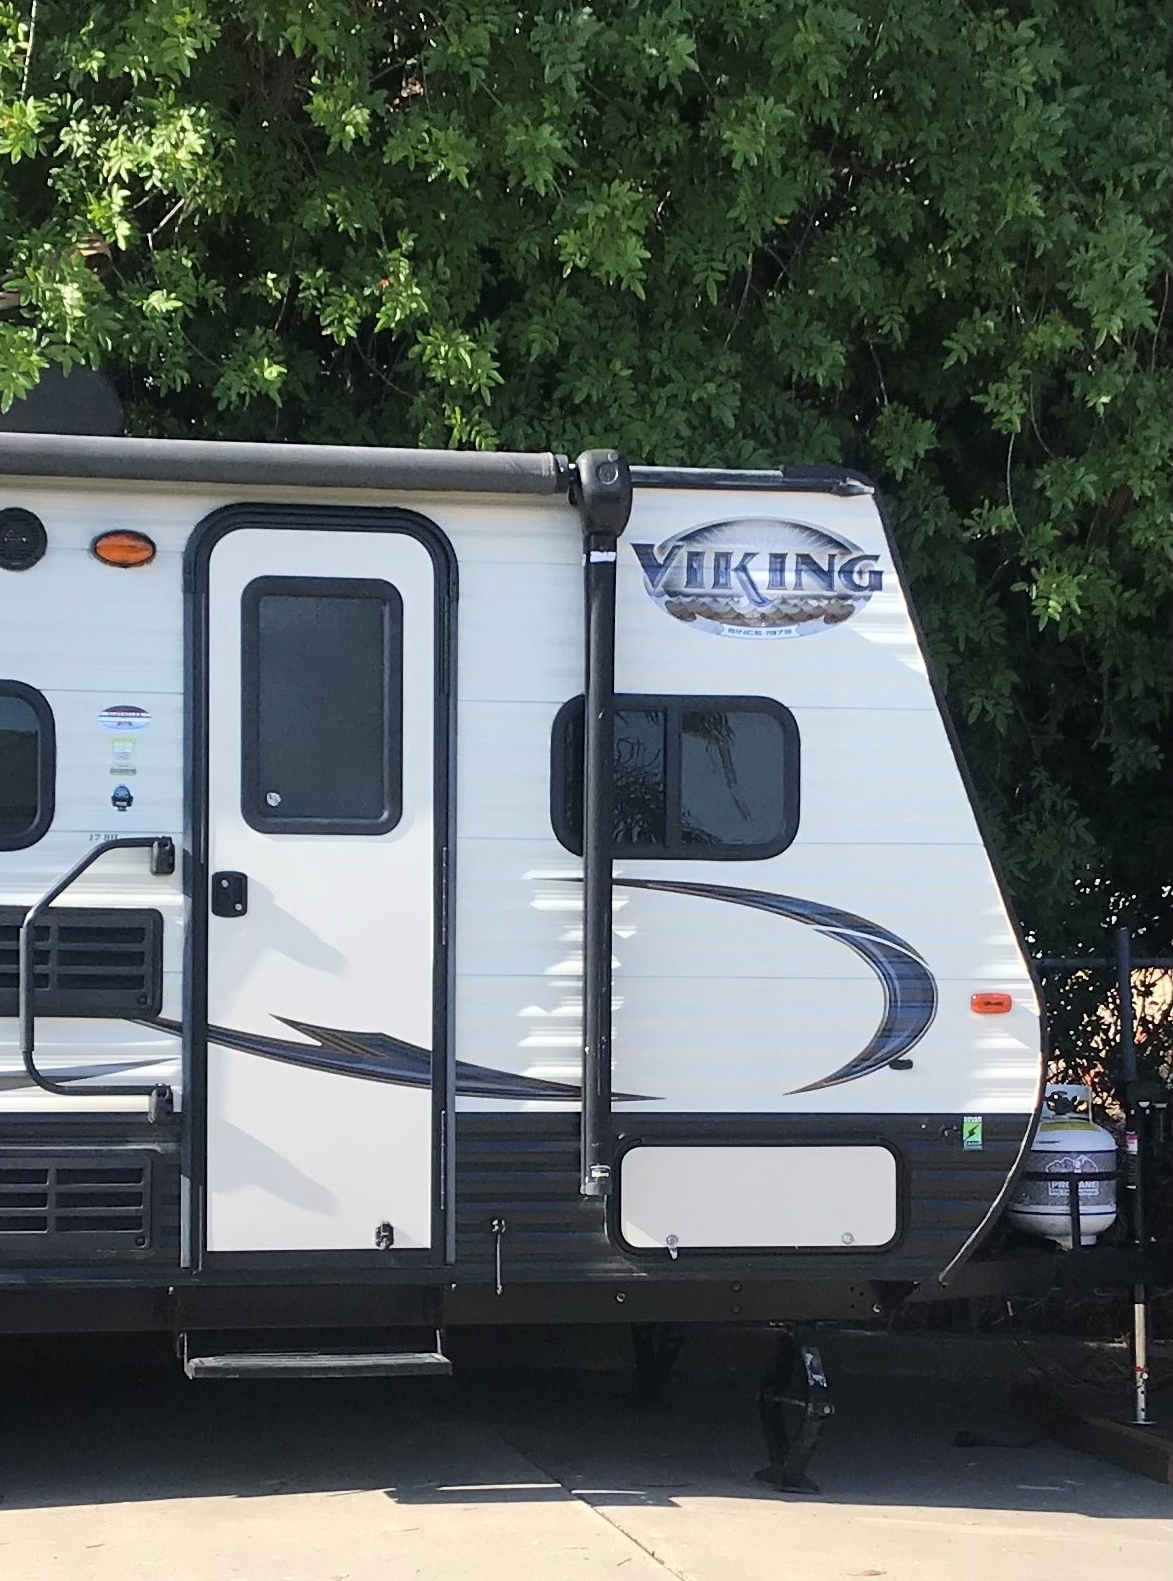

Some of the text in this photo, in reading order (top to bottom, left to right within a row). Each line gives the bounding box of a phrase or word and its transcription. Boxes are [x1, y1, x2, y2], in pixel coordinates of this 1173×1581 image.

[630, 542, 884, 608] VIKING
[727, 627, 763, 636] SINCE
[89, 833, 101, 841] 17
